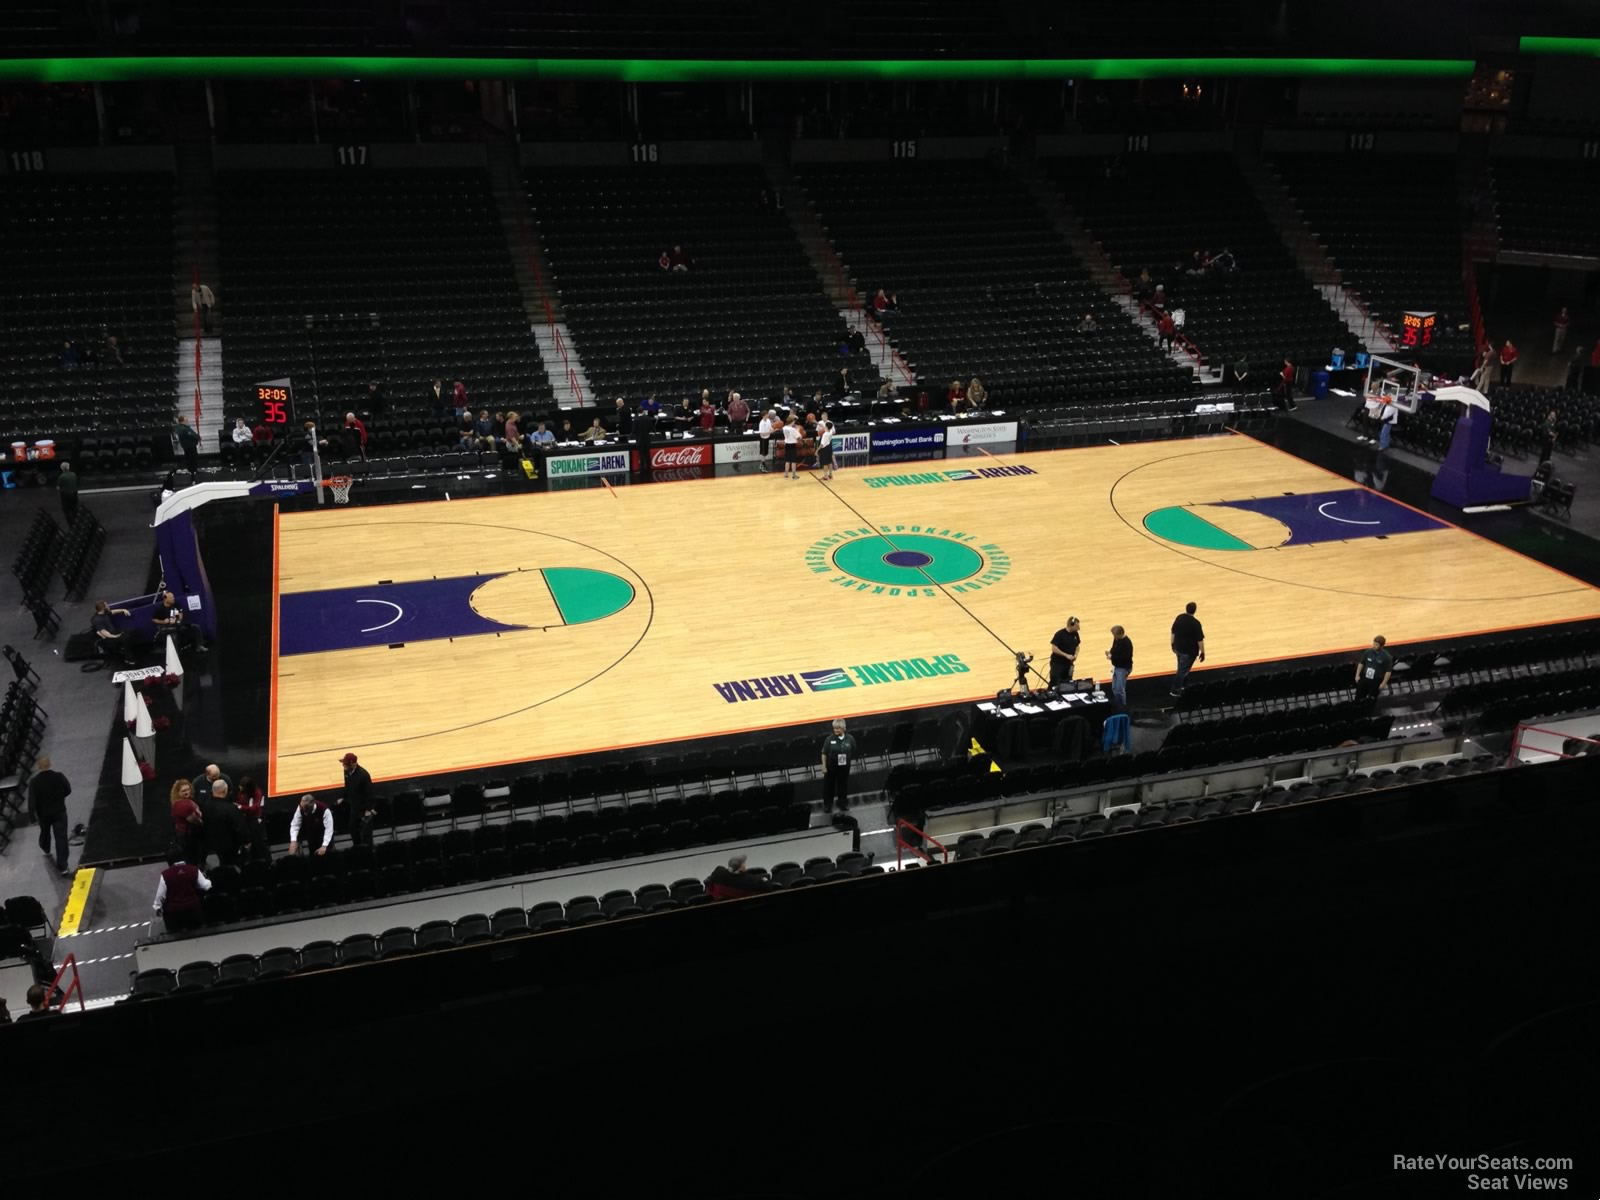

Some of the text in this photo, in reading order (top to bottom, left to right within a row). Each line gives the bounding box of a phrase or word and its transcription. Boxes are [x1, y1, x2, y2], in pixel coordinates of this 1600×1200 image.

[893, 140, 916, 158] 115
[1128, 135, 1149, 152] 114
[1350, 133, 1375, 150] 113
[10, 151, 45, 171] 118
[338, 145, 367, 165] 117
[631, 144, 658, 162] 116
[258, 387, 287, 401] 32:05
[263, 401, 287, 423] 35
[844, 435, 868, 451] ARENA
[872, 438, 905, 447] Washington
[918, 435, 933, 443] Bank
[551, 455, 626, 474] SPOKANE ARENA
[651, 446, 705, 467] Coca-Cola
[863, 464, 1038, 489] SPOKANE ARENA
[270, 483, 299, 492] SPALDING
[880, 525, 978, 542] SPOKANE
[804, 527, 872, 574] WASHINGTON
[951, 543, 1012, 593] WASHINGTON
[829, 575, 937, 597] SPOKANE
[712, 653, 971, 704] SPOKANE ARENA
